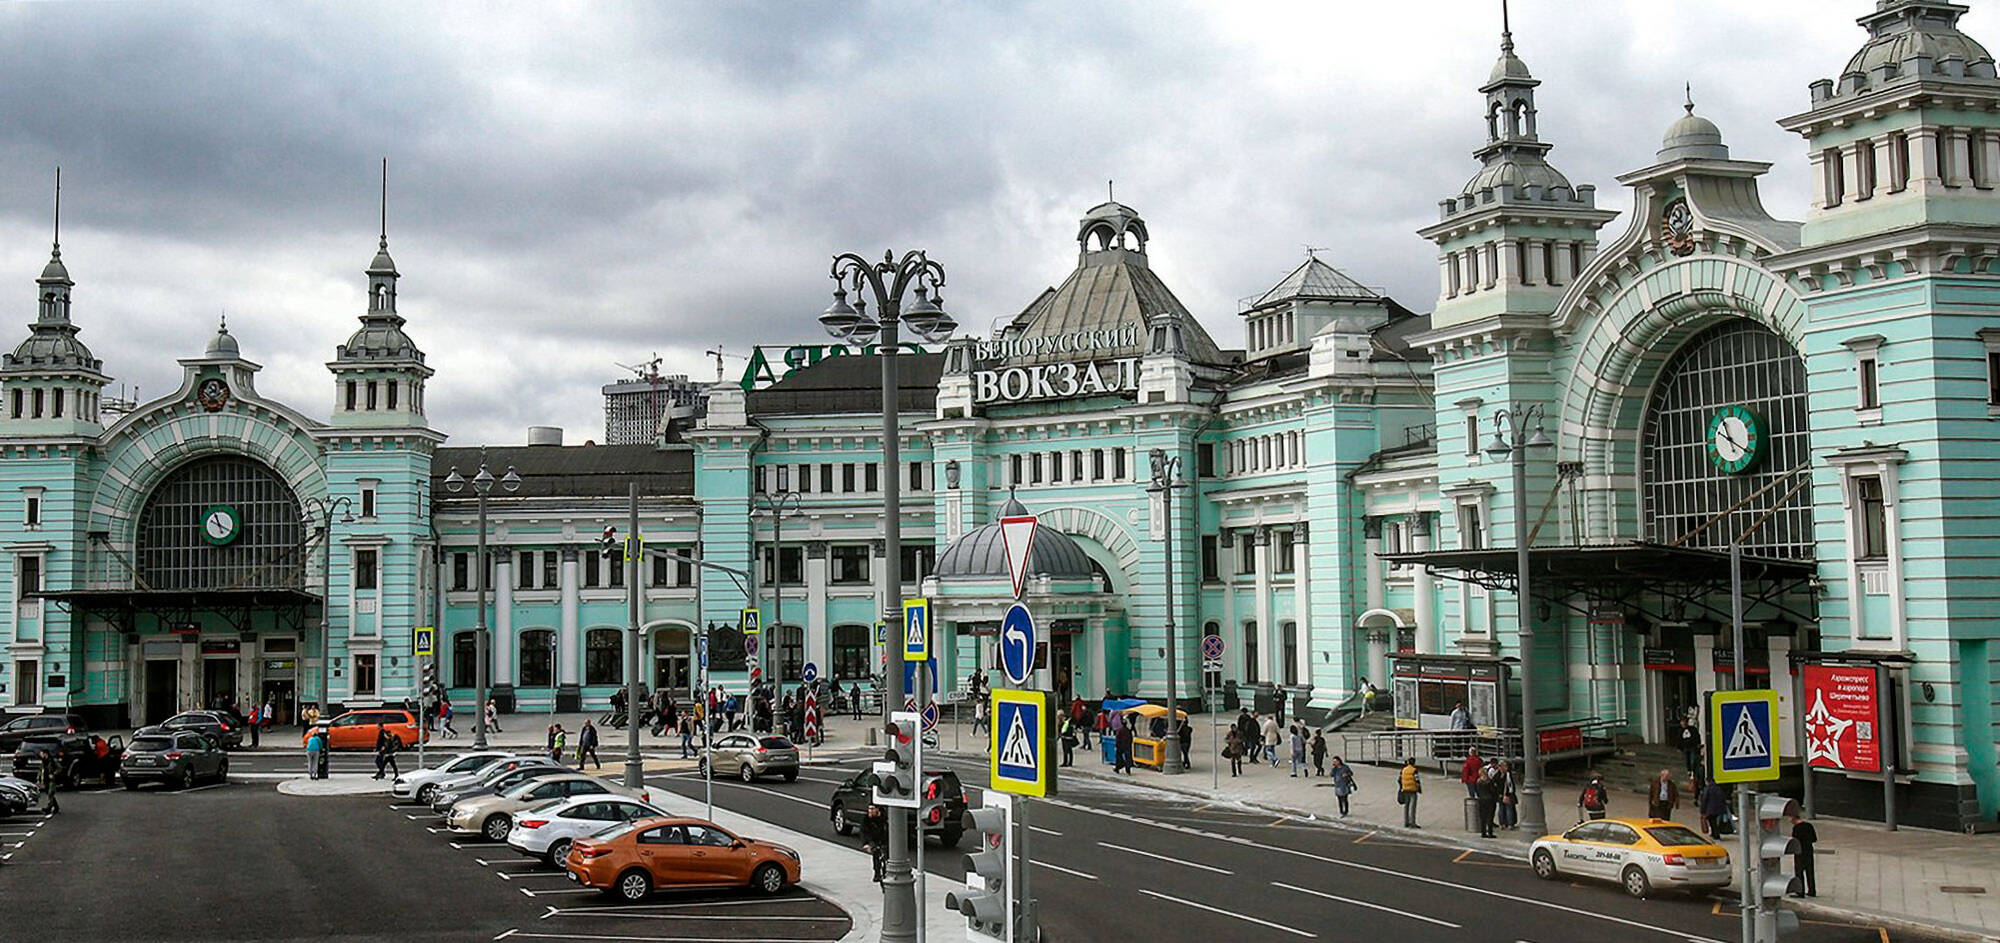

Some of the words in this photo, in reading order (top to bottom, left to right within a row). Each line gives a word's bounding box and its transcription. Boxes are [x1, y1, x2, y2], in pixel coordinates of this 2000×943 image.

[975, 322, 1138, 362] БЕЛОРУССКИЙ
[974, 358, 1138, 402] ВОКЗАЛ
[1829, 692, 1870, 702] Шереметьево
